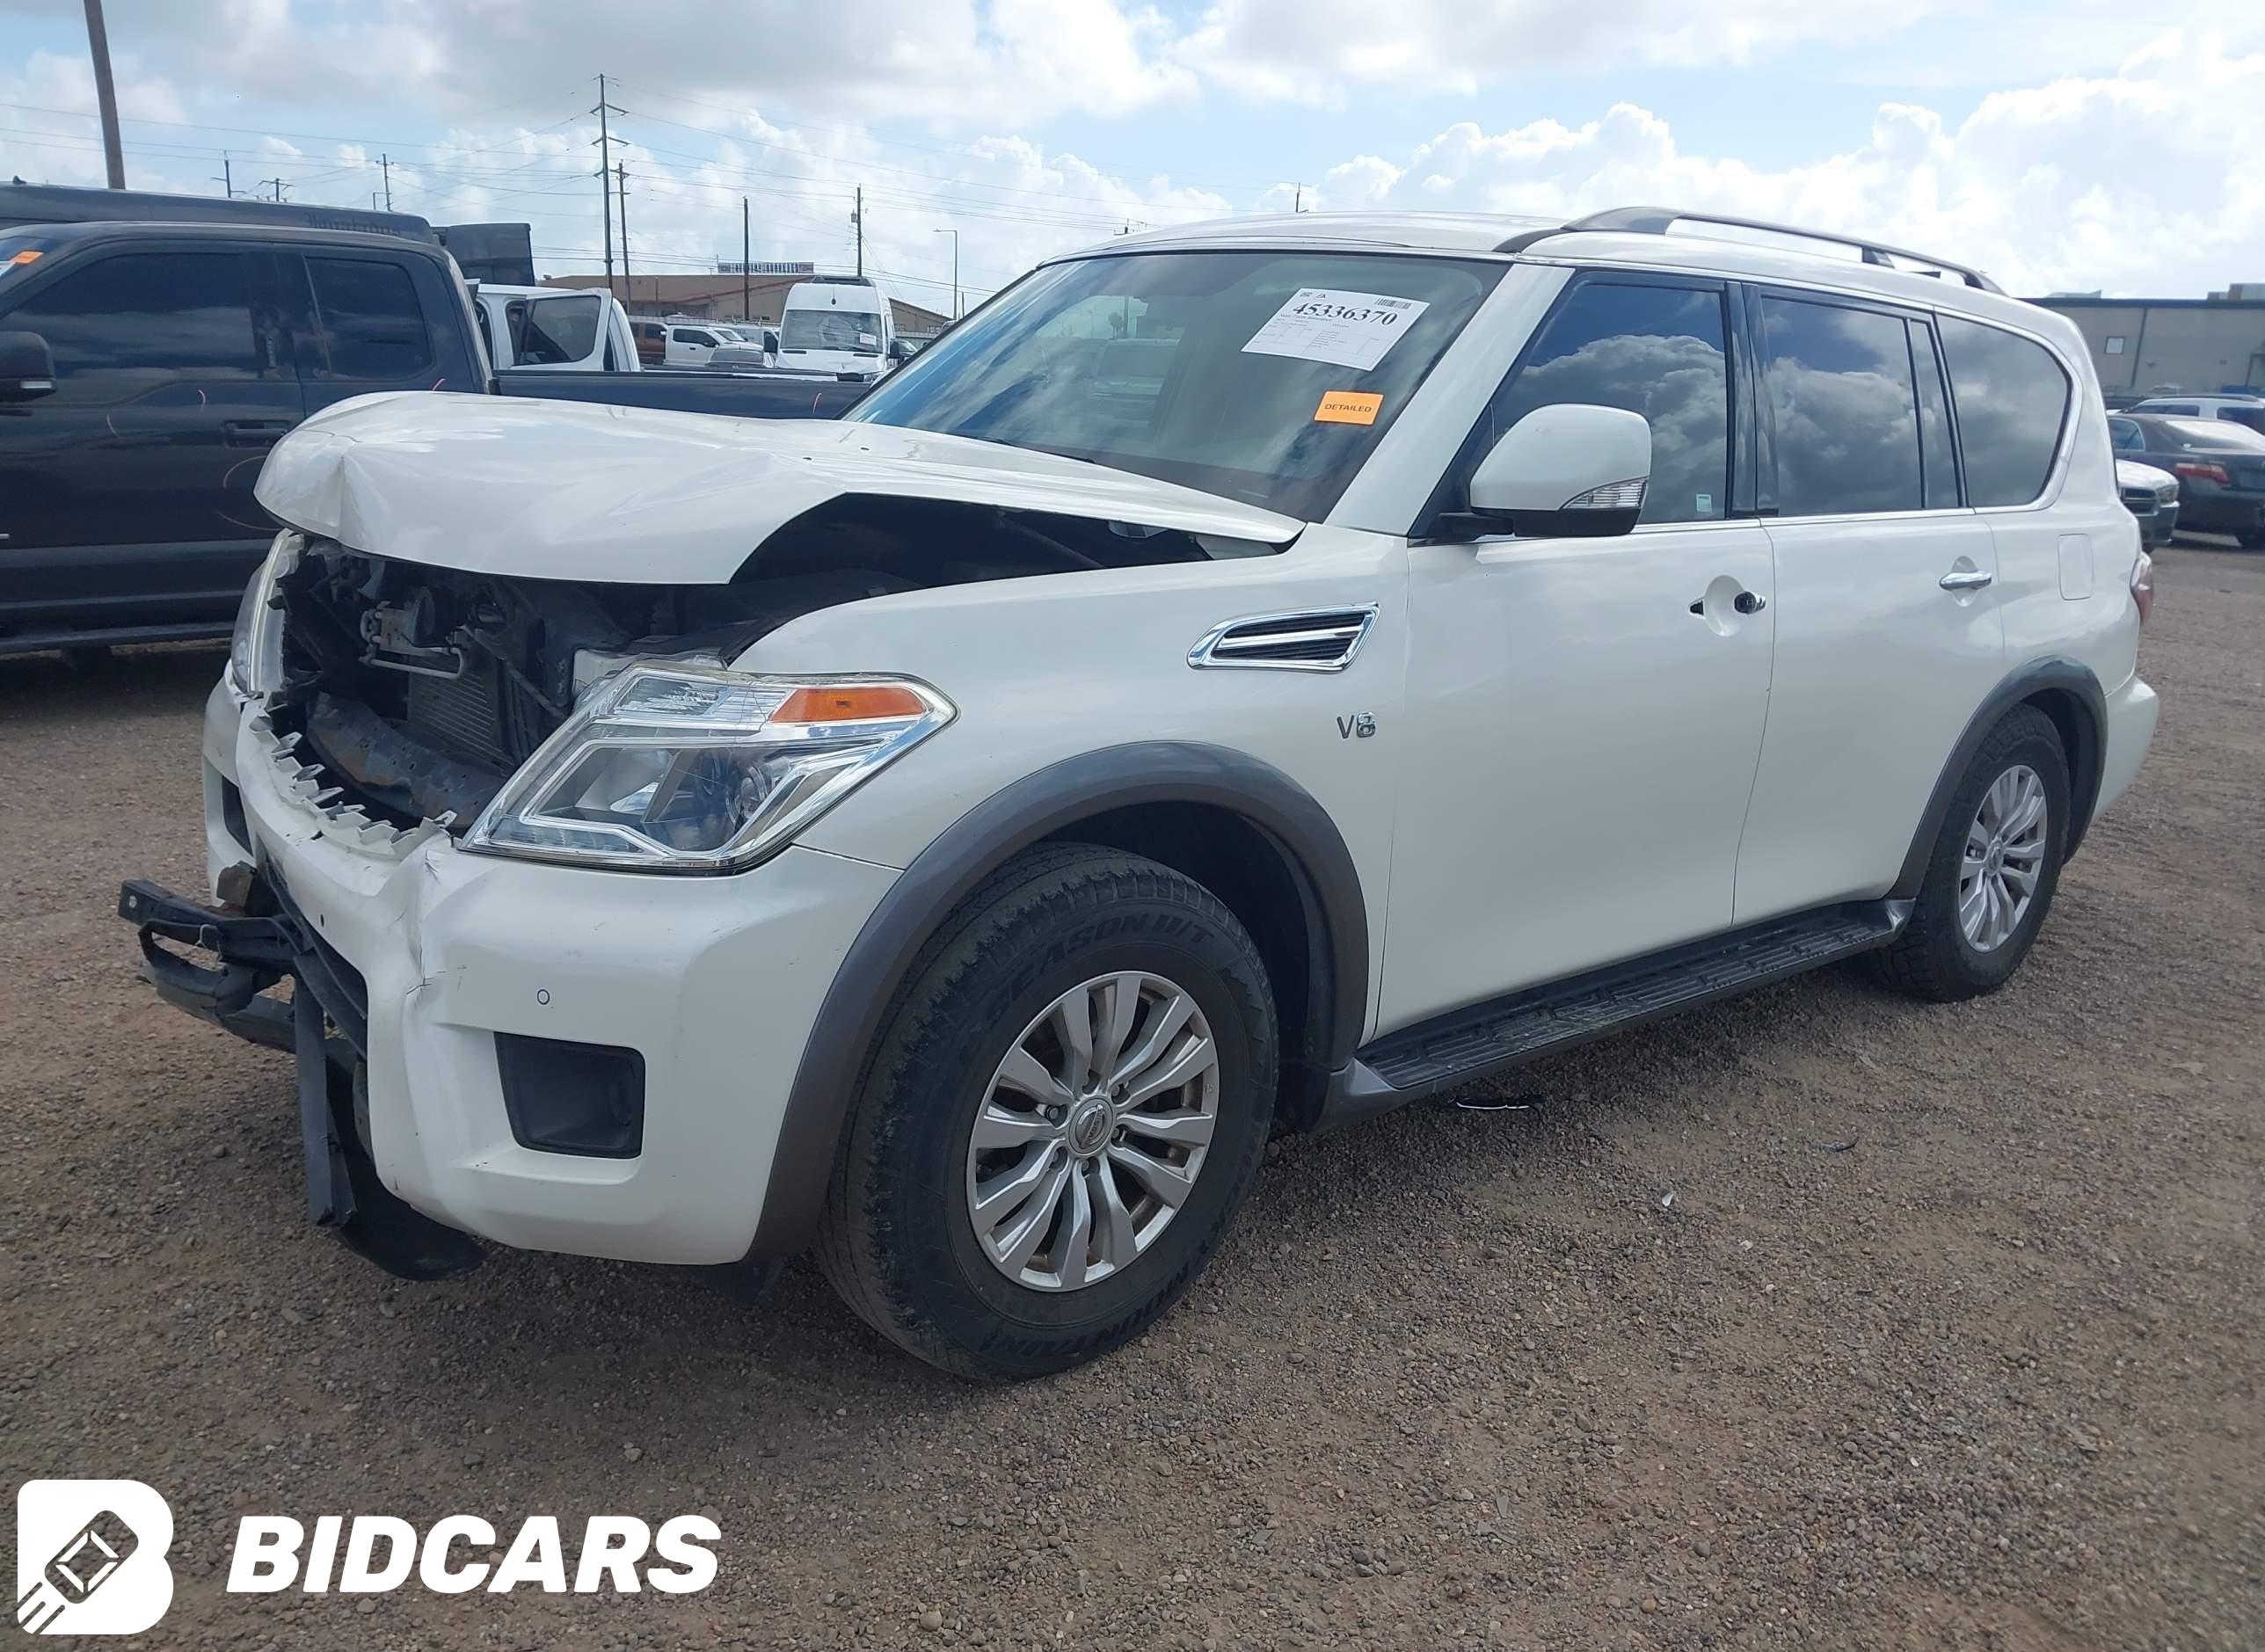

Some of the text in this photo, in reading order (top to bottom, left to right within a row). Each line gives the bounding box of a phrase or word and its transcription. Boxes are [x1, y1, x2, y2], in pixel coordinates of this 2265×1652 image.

[1293, 302, 1398, 326] 45336370
[1324, 403, 1373, 413] DETAILED
[1336, 712, 1376, 739] V8
